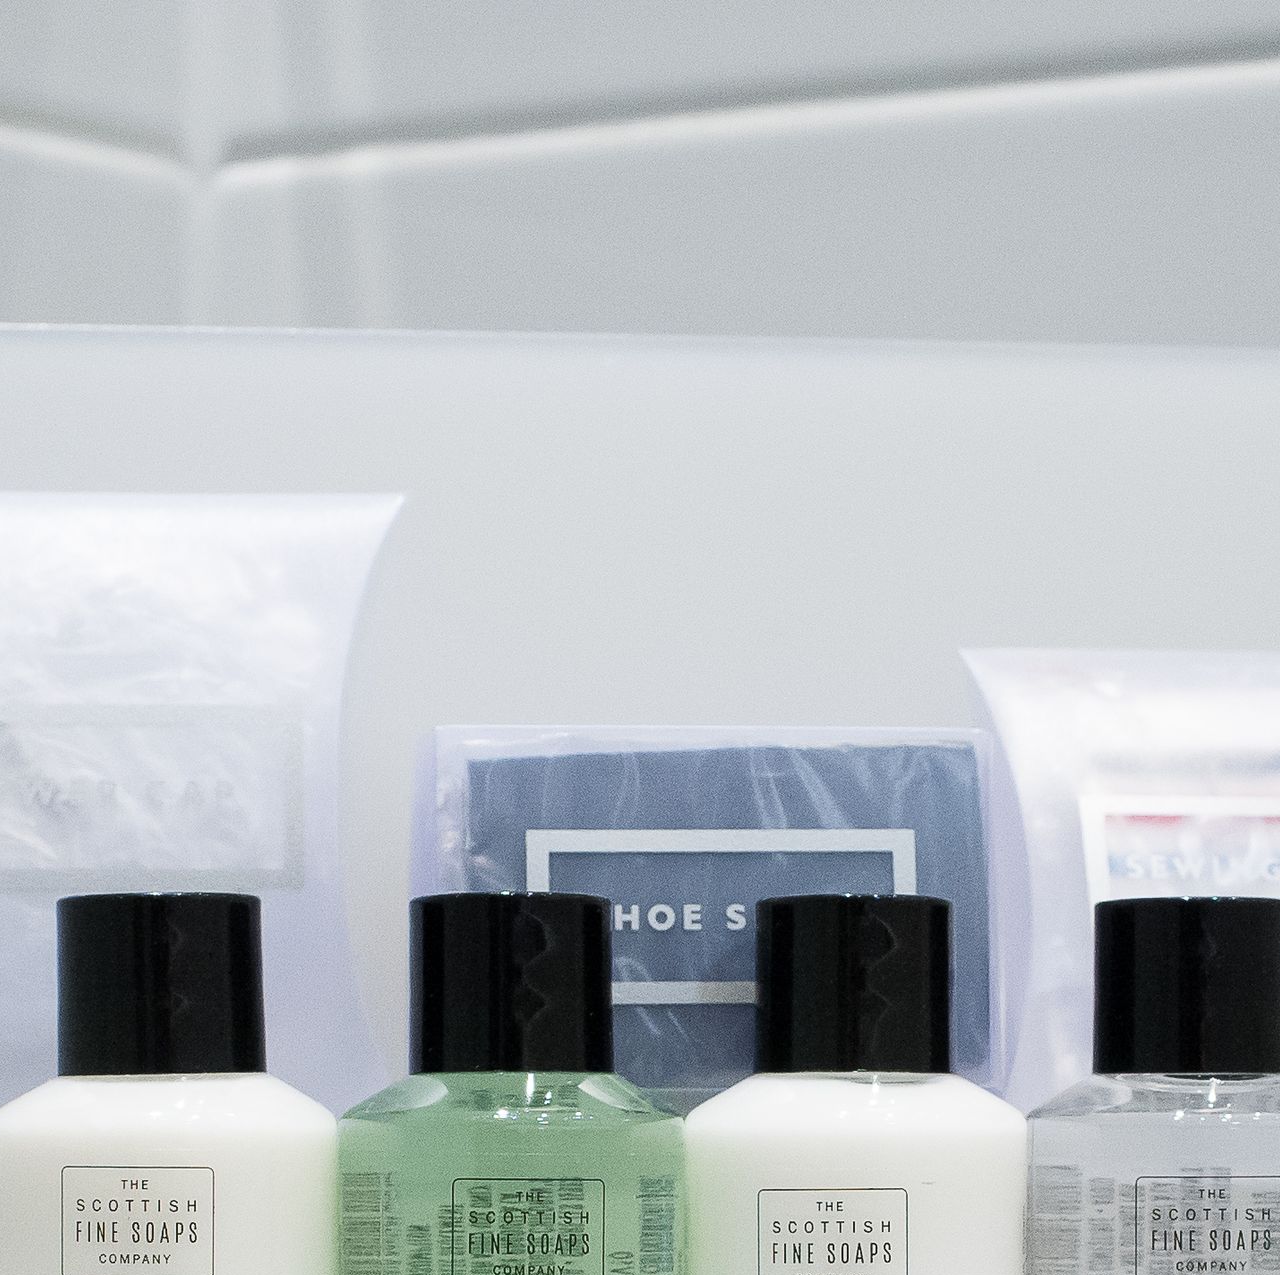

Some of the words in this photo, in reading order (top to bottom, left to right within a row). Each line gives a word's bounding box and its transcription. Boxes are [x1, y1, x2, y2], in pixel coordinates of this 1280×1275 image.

[613, 903, 703, 930] HOE
[121, 1179, 150, 1190] THE
[515, 1191, 544, 1203] THE
[1198, 1188, 1227, 1200] THE
[76, 1198, 199, 1213] SCOTTISH
[816, 1201, 844, 1212] THE
[468, 1210, 590, 1225] SCOTTISH
[1151, 1208, 1272, 1222] SCOTTISH
[75, 1221, 119, 1243] FINE
[131, 1221, 199, 1244] SOAPS
[772, 1220, 892, 1234] SCOTTISH
[468, 1232, 514, 1255] FINE
[526, 1232, 591, 1255] SOAPS
[1151, 1229, 1197, 1251] FINE
[1208, 1229, 1272, 1251] SOAPS
[98, 1253, 172, 1265] COMPANY
[772, 1242, 815, 1264] FINE
[827, 1242, 893, 1264] SOAPS
[1175, 1261, 1248, 1272] COMPANY
